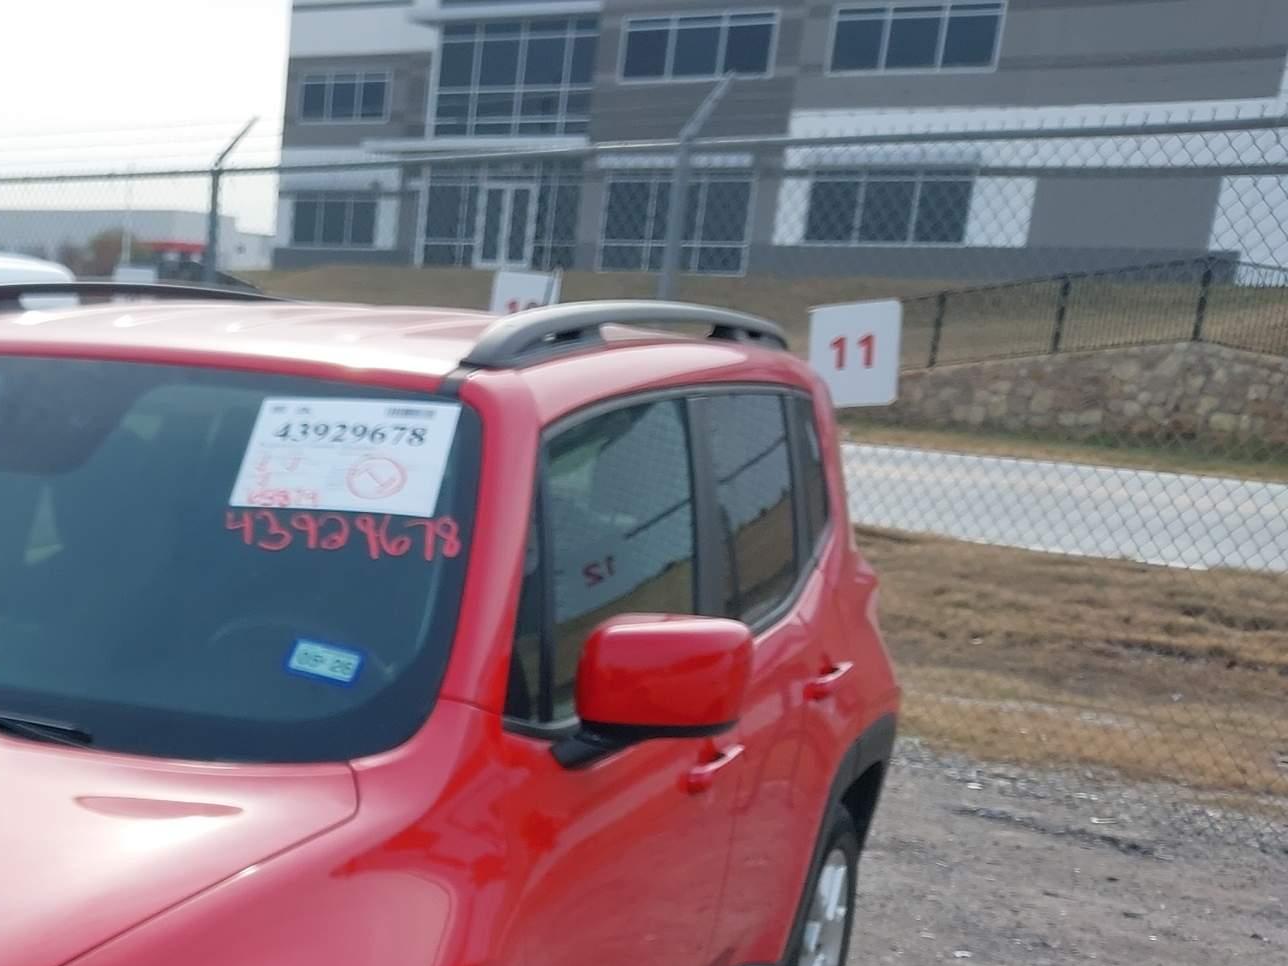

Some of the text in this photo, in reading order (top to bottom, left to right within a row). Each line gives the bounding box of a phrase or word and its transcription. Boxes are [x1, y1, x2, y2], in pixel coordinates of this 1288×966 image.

[828, 334, 877, 370] 11
[272, 421, 430, 448] 43929678
[224, 510, 463, 562] 43929678
